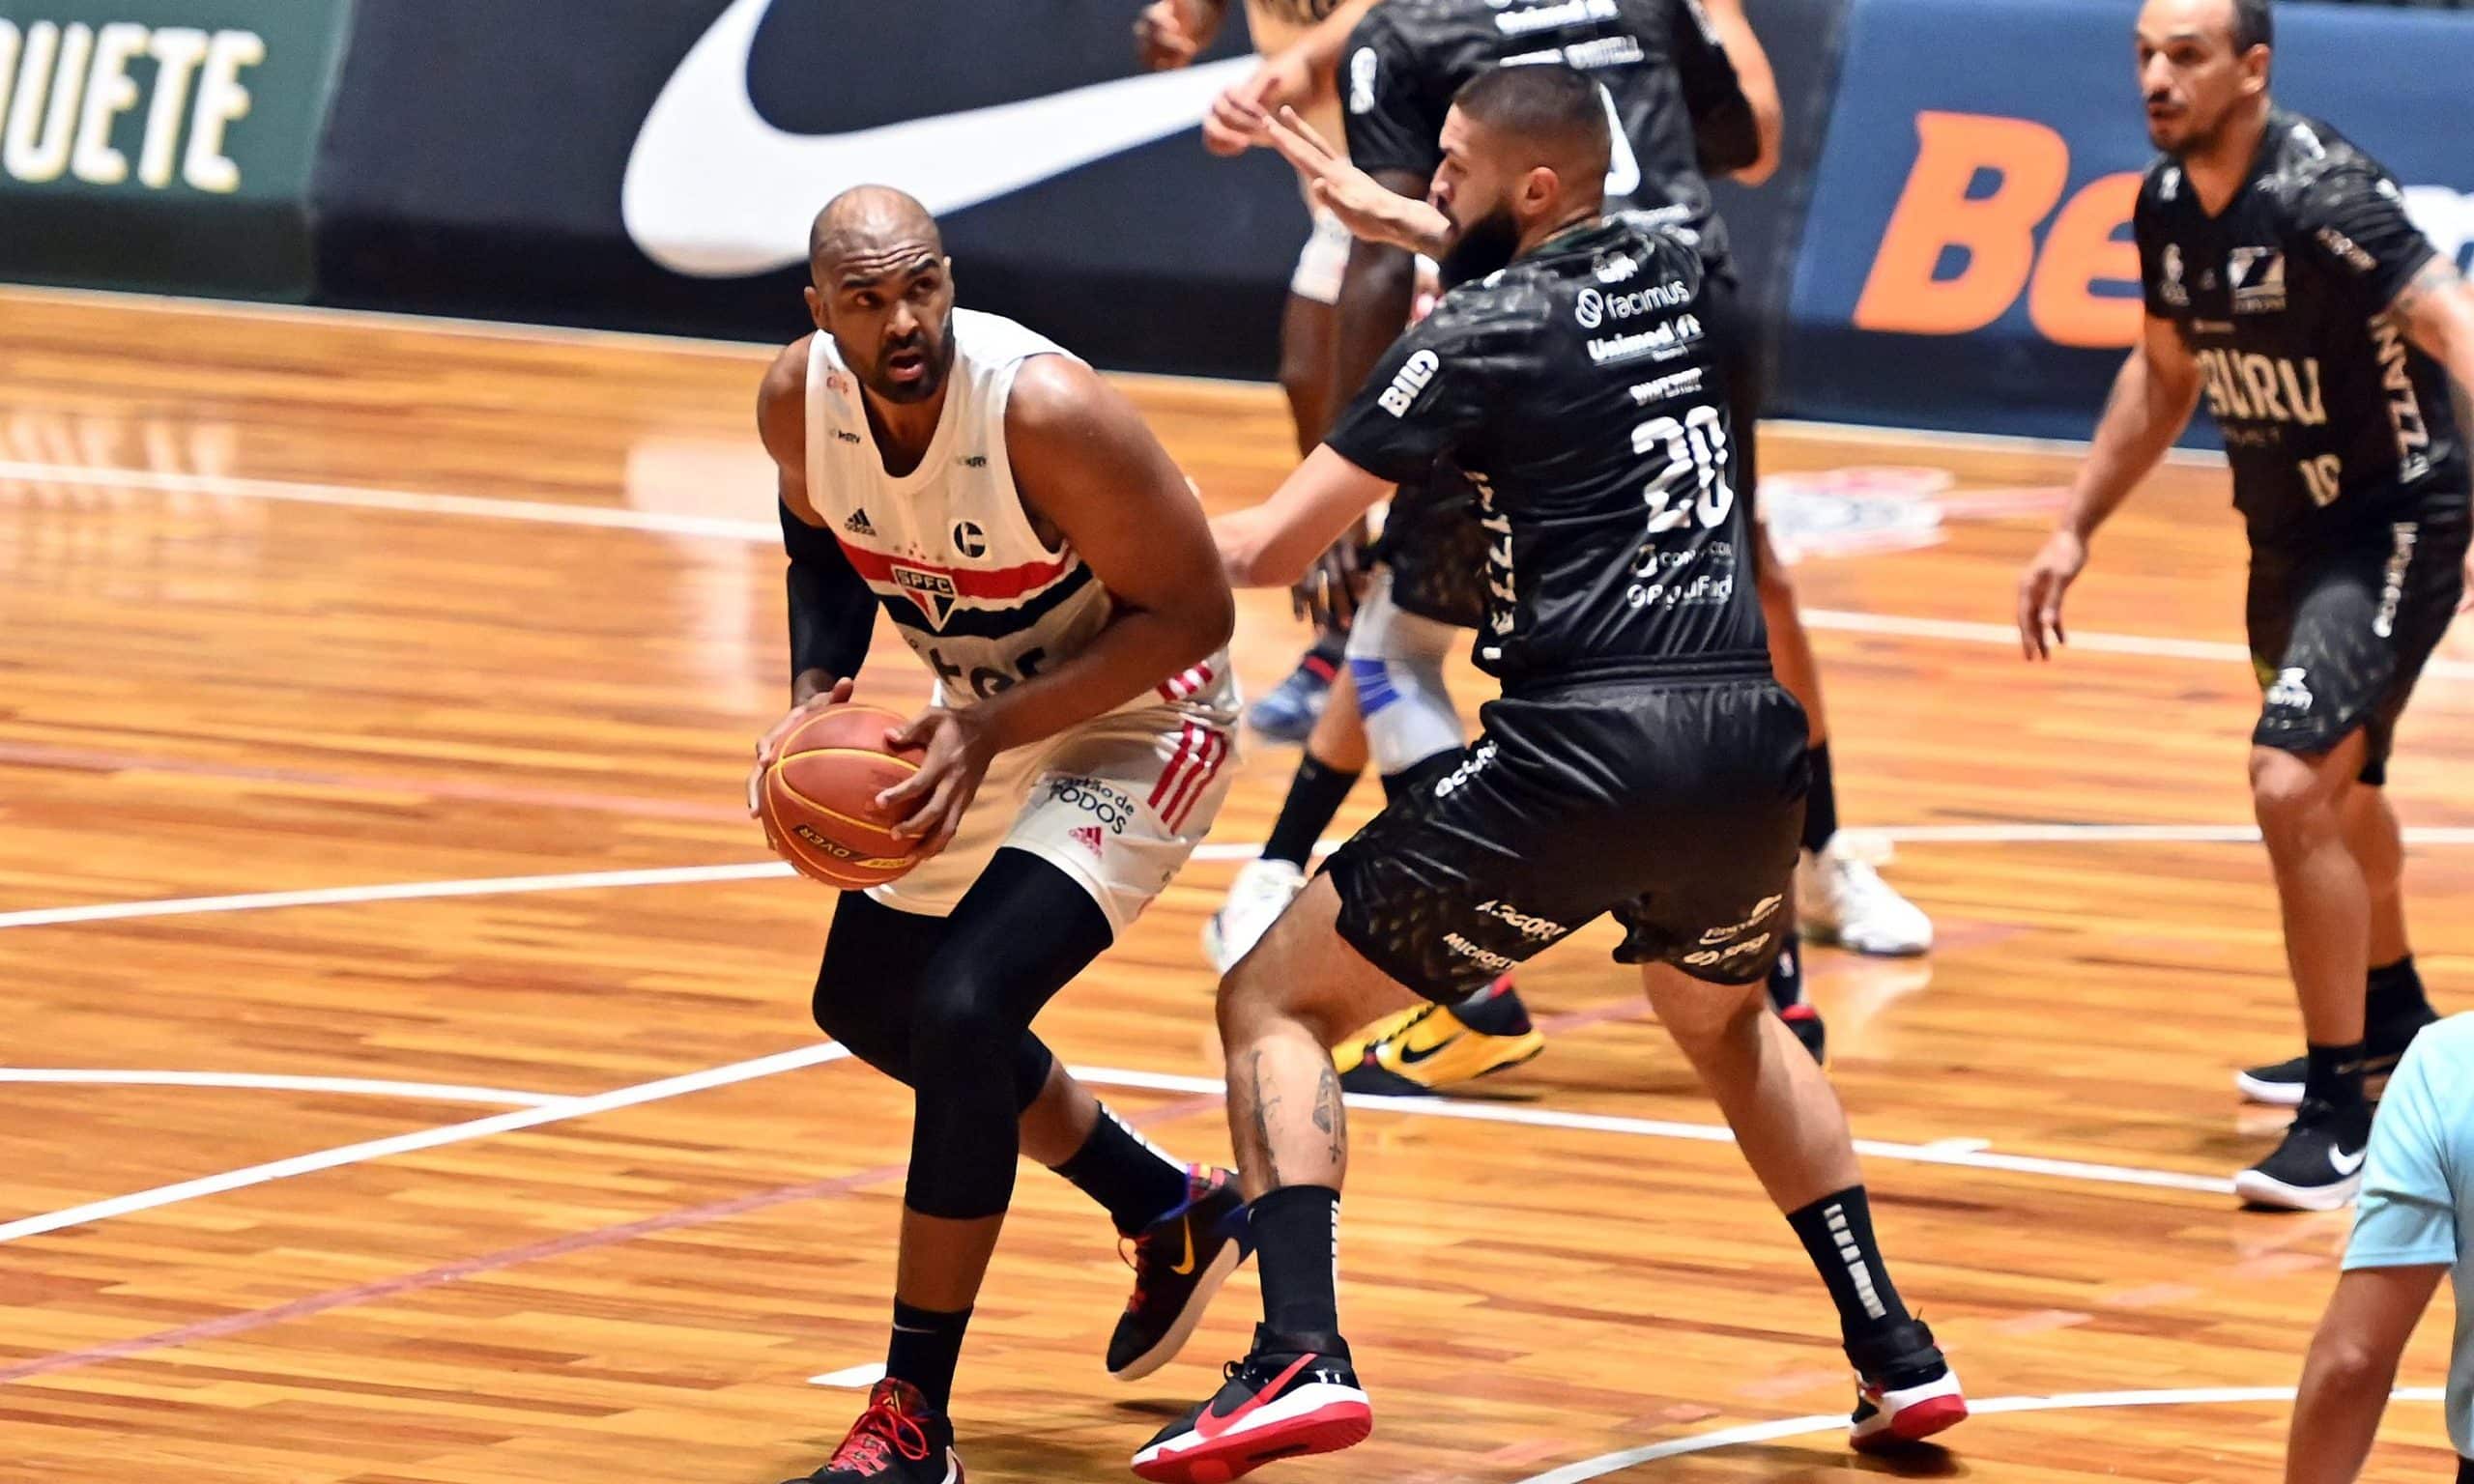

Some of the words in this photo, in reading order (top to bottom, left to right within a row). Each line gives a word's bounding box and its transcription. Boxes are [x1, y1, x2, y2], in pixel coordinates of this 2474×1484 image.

[1852, 109, 2147, 348] Be
[1605, 280, 1690, 320] facimus
[1378, 349, 1440, 418] BILD
[1631, 405, 1734, 533] 20
[797, 827, 851, 859] OVER
